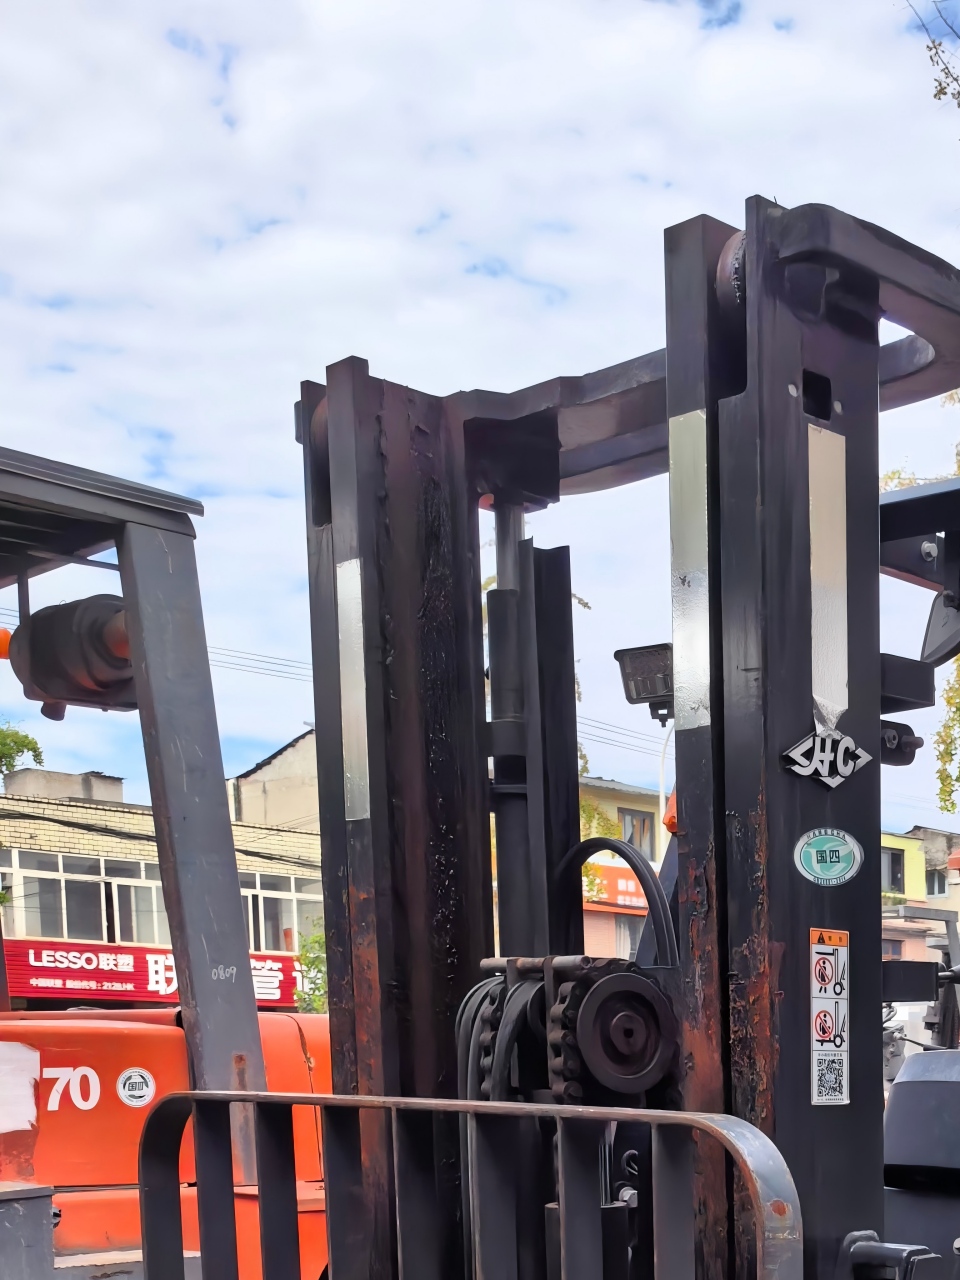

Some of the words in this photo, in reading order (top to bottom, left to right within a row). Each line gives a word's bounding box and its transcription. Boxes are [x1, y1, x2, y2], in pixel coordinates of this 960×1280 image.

[28, 949, 98, 970] LESSO
[98, 953, 135, 972] 联塑
[211, 965, 237, 983] 0809
[43, 1066, 101, 1111] 70
